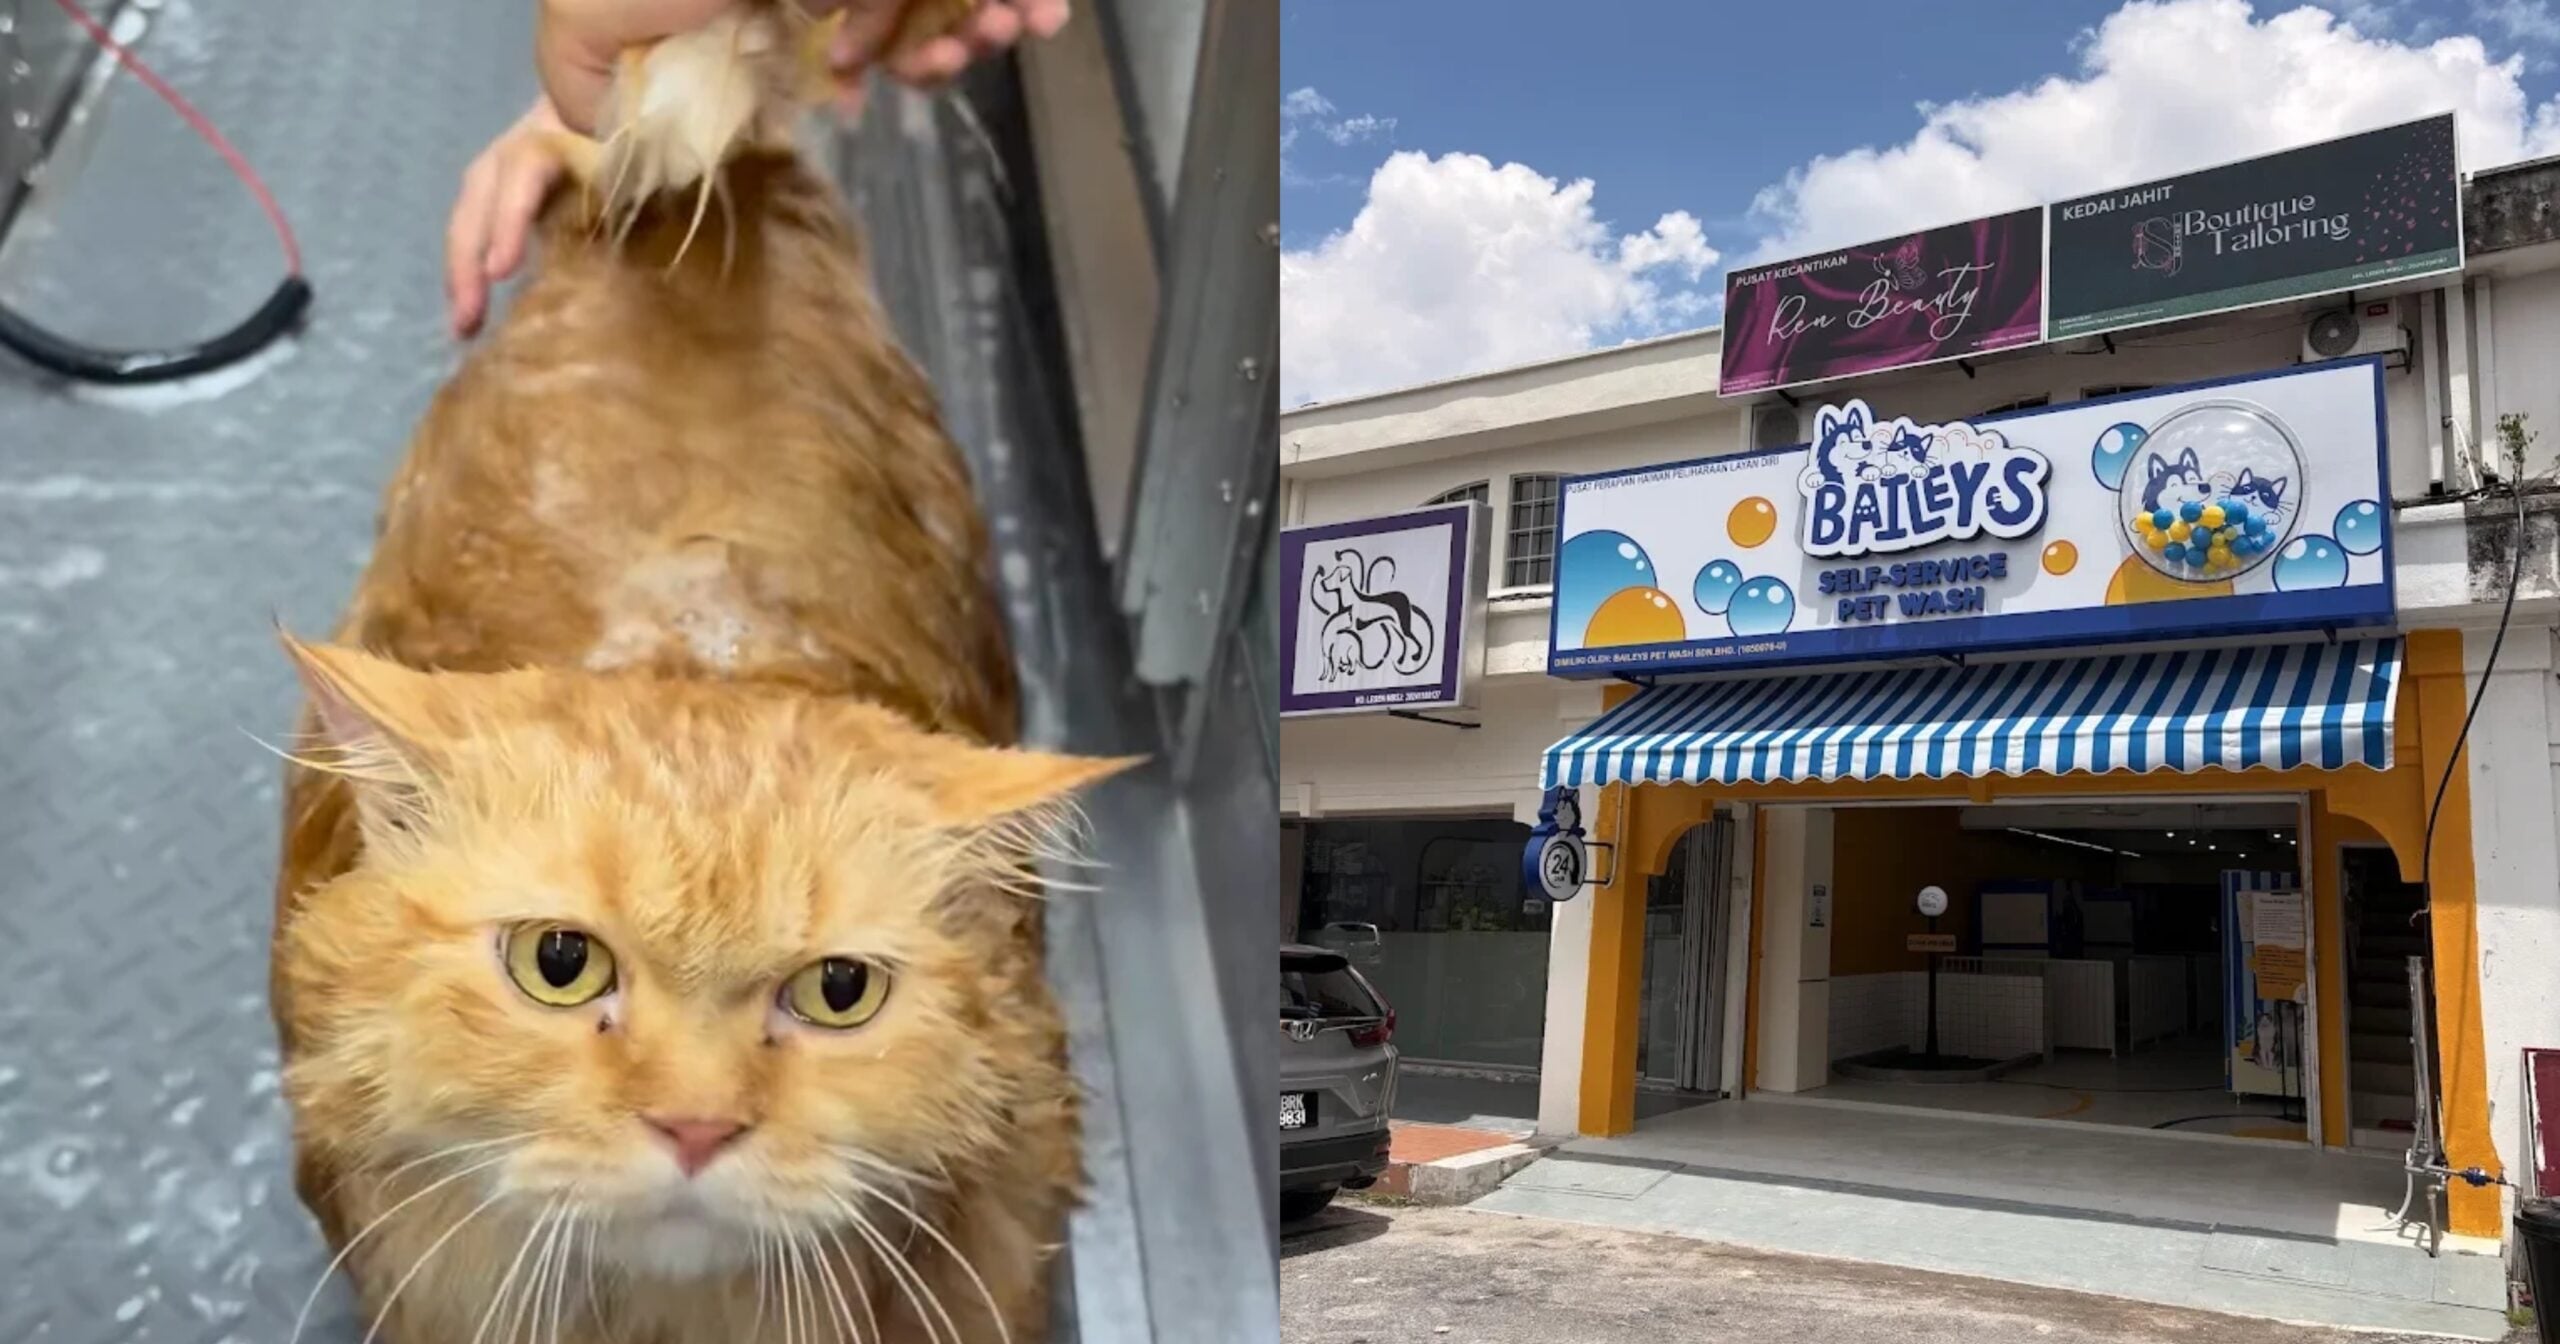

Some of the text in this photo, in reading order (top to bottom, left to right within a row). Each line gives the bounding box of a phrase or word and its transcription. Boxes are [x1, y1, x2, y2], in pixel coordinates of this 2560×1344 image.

[2063, 185, 2174, 221] KEDAI JAHIT
[2184, 194, 2316, 235] Boutique
[2207, 212, 2350, 255] Tailoring
[1735, 255, 1848, 288] PUSAT KECANTIKAN
[1767, 295, 1836, 345] Ren
[1847, 262, 1996, 341] Beauty
[1567, 482, 1592, 493] PUSAT
[1594, 476, 1636, 490] PERAPIAN
[1730, 458, 1760, 472] LAYAN
[1761, 456, 1780, 467] DIRI
[1818, 552, 2007, 594] SELF-SERVICE
[1838, 586, 1985, 622] PET WASH
[1613, 651, 1649, 663] BAILEYS
[1650, 651, 1667, 660] PET
[1668, 649, 1694, 659] WASH
[1550, 854, 1570, 875] 24
[1280, 1093, 1304, 1111] BRK
[1280, 1109, 1306, 1125] 9831
